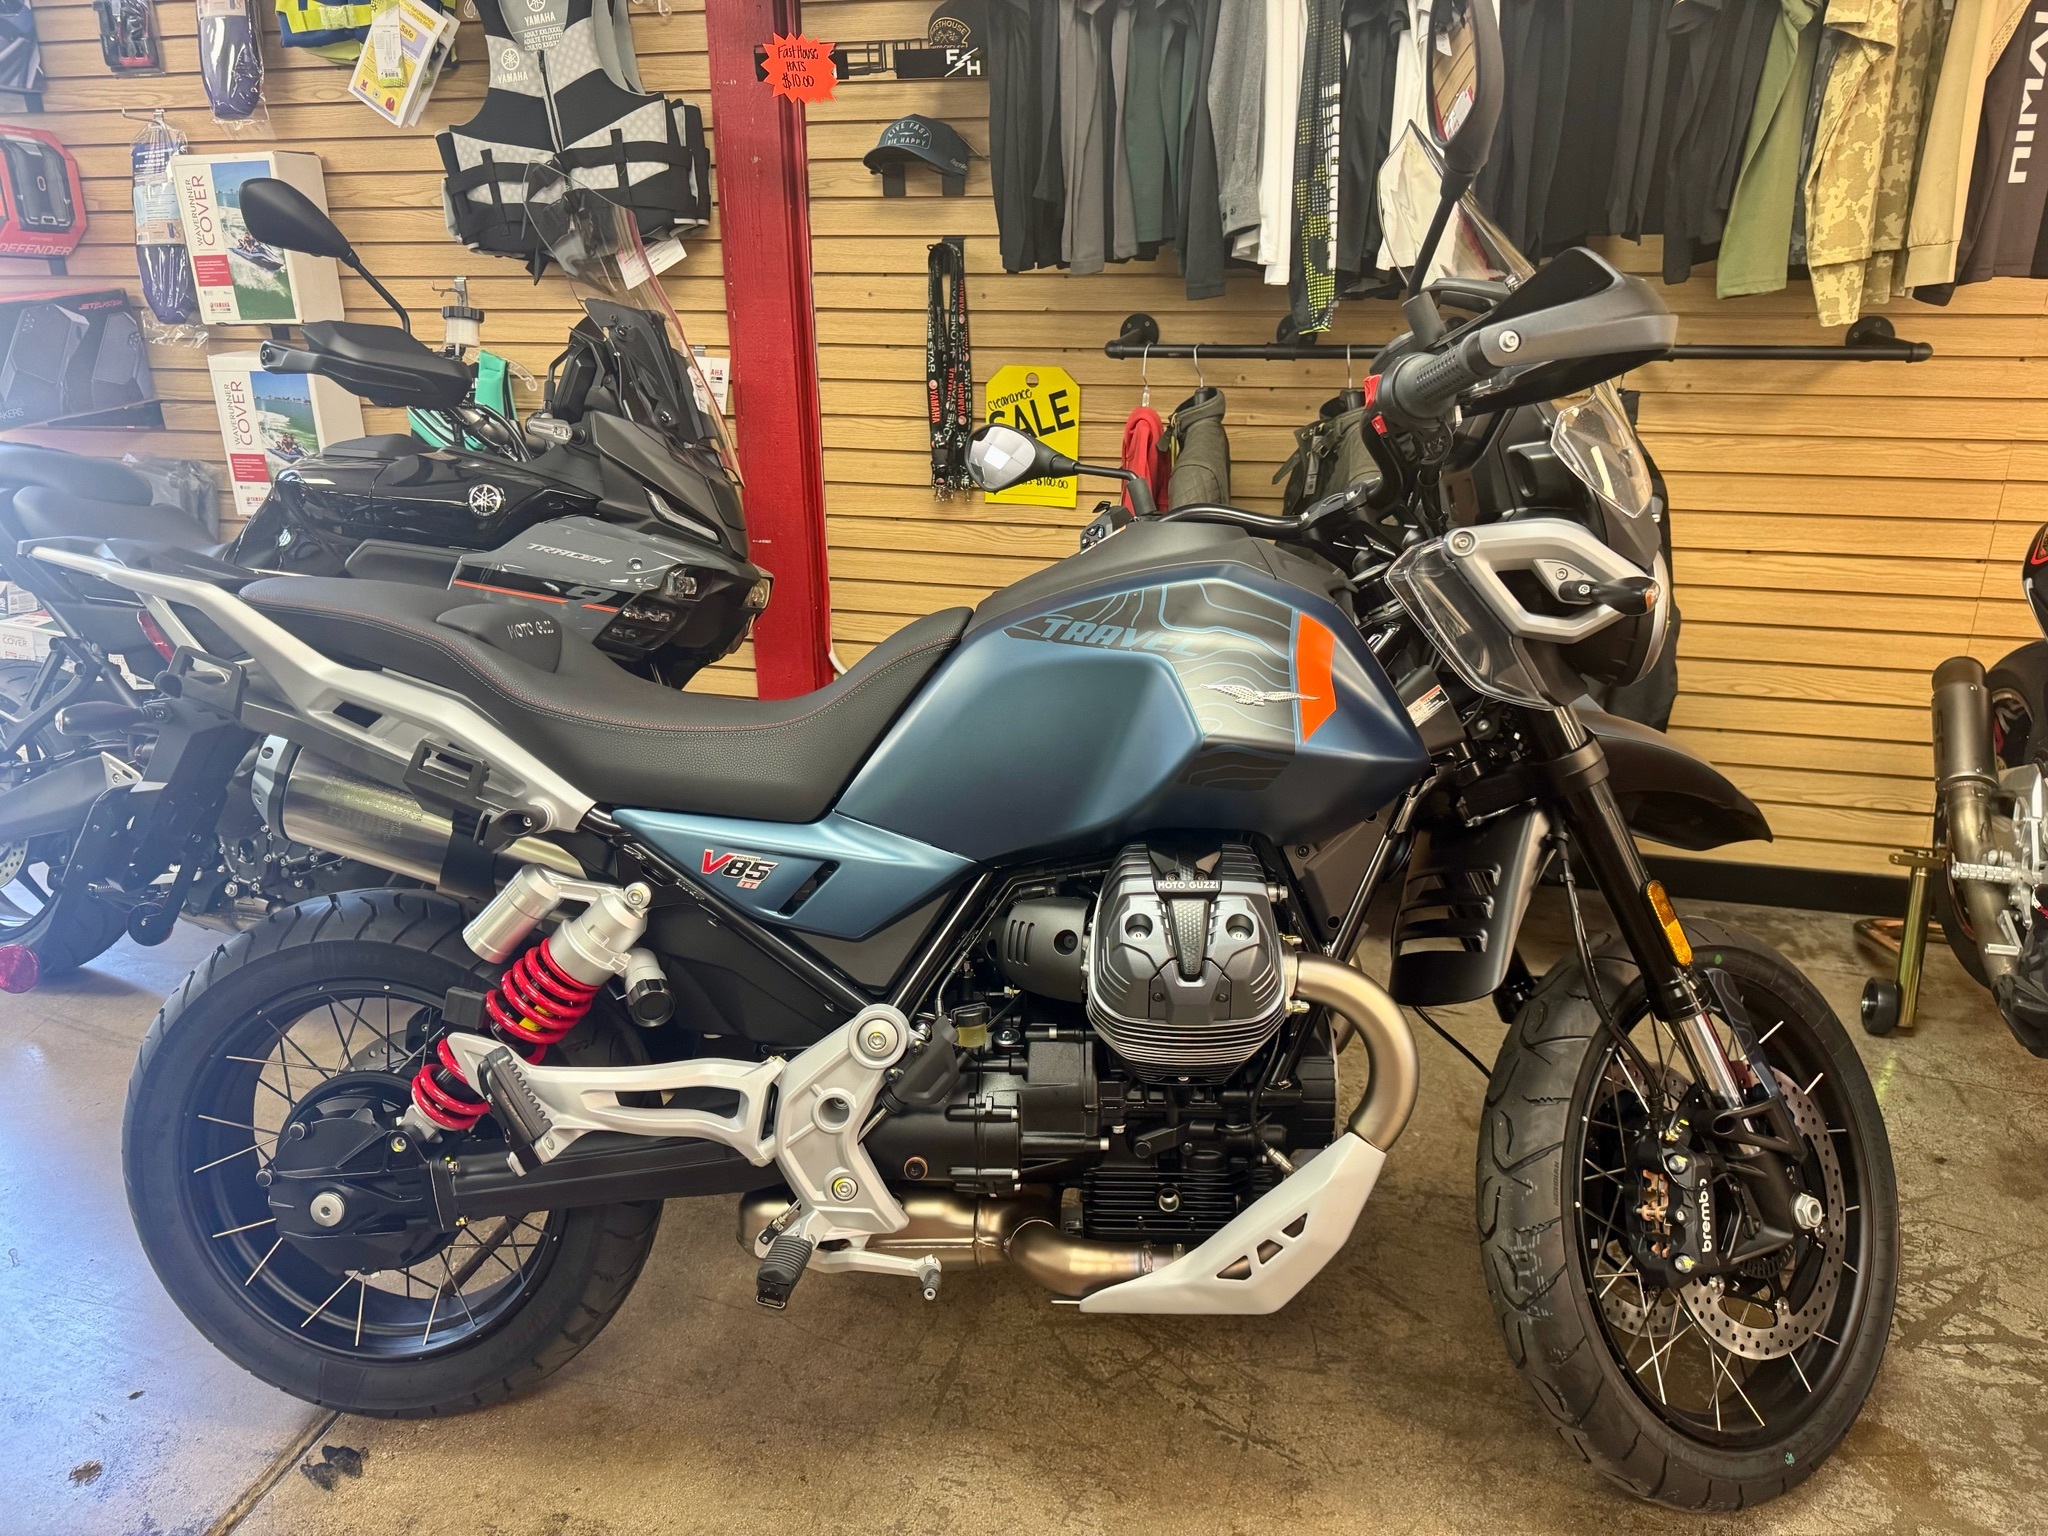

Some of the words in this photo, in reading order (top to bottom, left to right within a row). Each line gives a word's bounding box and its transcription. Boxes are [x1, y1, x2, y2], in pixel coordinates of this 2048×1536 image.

[524, 12, 556, 26] YAMAHA
[400, 24, 414, 39] Safe
[524, 29, 539, 38] ADULT
[524, 37, 541, 45] ADULTE
[541, 32, 564, 42] TTG/TTT
[786, 61, 807, 72] HATS
[498, 70, 528, 84] YAMAHA
[782, 72, 815, 90] $10.00
[888, 122, 905, 138] LIVE
[909, 122, 930, 138] FAST
[900, 137, 927, 146] HAPPY
[185, 179, 203, 246] WAVERUNNER
[192, 175, 216, 246] COVER
[0, 243, 72, 256] DEFENDER
[930, 389, 940, 424] YAMAHA
[988, 388, 1032, 412] Clearance
[224, 384, 240, 445] WAVERUNNER
[230, 381, 253, 446] COVER
[526, 542, 613, 566] TRACER
[506, 622, 534, 640] MOTO
[1041, 616, 1202, 658] TRAVEL
[2, 636, 28, 647] COVER
[701, 848, 779, 881] V85
[741, 880, 758, 888] TT
[1156, 880, 1186, 890] MOTO
[1188, 880, 1220, 890] GUZZI
[1699, 1177, 1713, 1253] brembo
